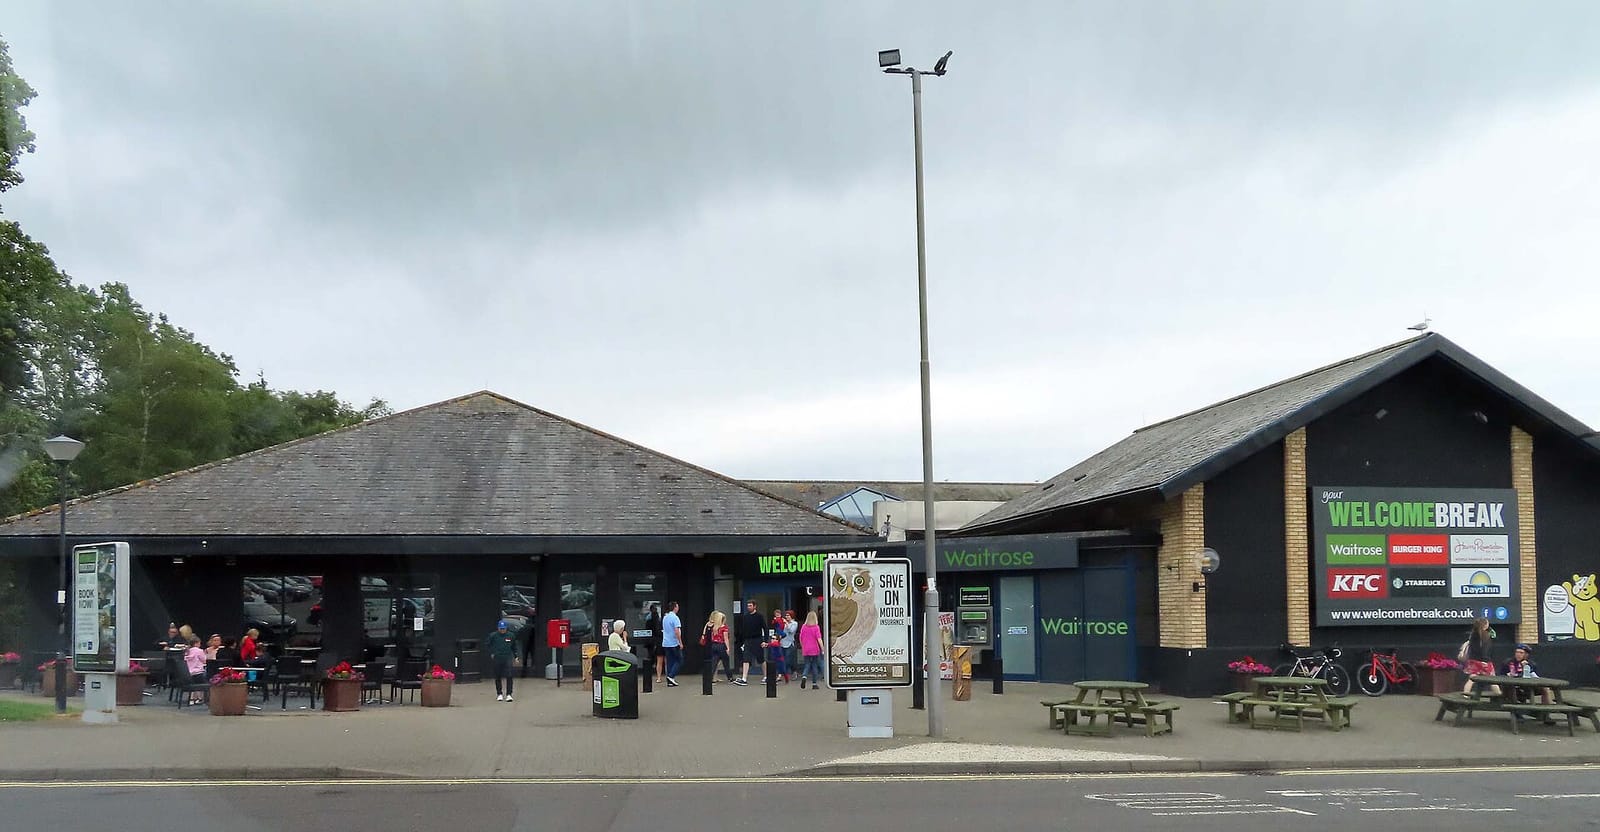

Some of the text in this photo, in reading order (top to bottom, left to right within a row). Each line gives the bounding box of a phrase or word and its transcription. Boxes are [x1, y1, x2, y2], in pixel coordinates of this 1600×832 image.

[1321, 491, 1343, 504] your
[1328, 502, 1504, 528] WELCOMEBREAK
[1330, 544, 1382, 555] Waitrose
[1392, 545, 1422, 553] BURGER
[944, 547, 1035, 567] Waitrose
[879, 574, 904, 588] SAVE
[1332, 574, 1382, 592] KFC
[1404, 579, 1446, 587] STARBUCKS
[79, 589, 95, 599] BOOK
[1462, 586, 1484, 595] Days
[885, 590, 899, 605] ON
[880, 607, 904, 617] MOTOR
[1331, 608, 1474, 619] www.welcomebreak.co.uk
[880, 618, 904, 626] INSURANCE
[866, 647, 904, 656] Be Wiser
